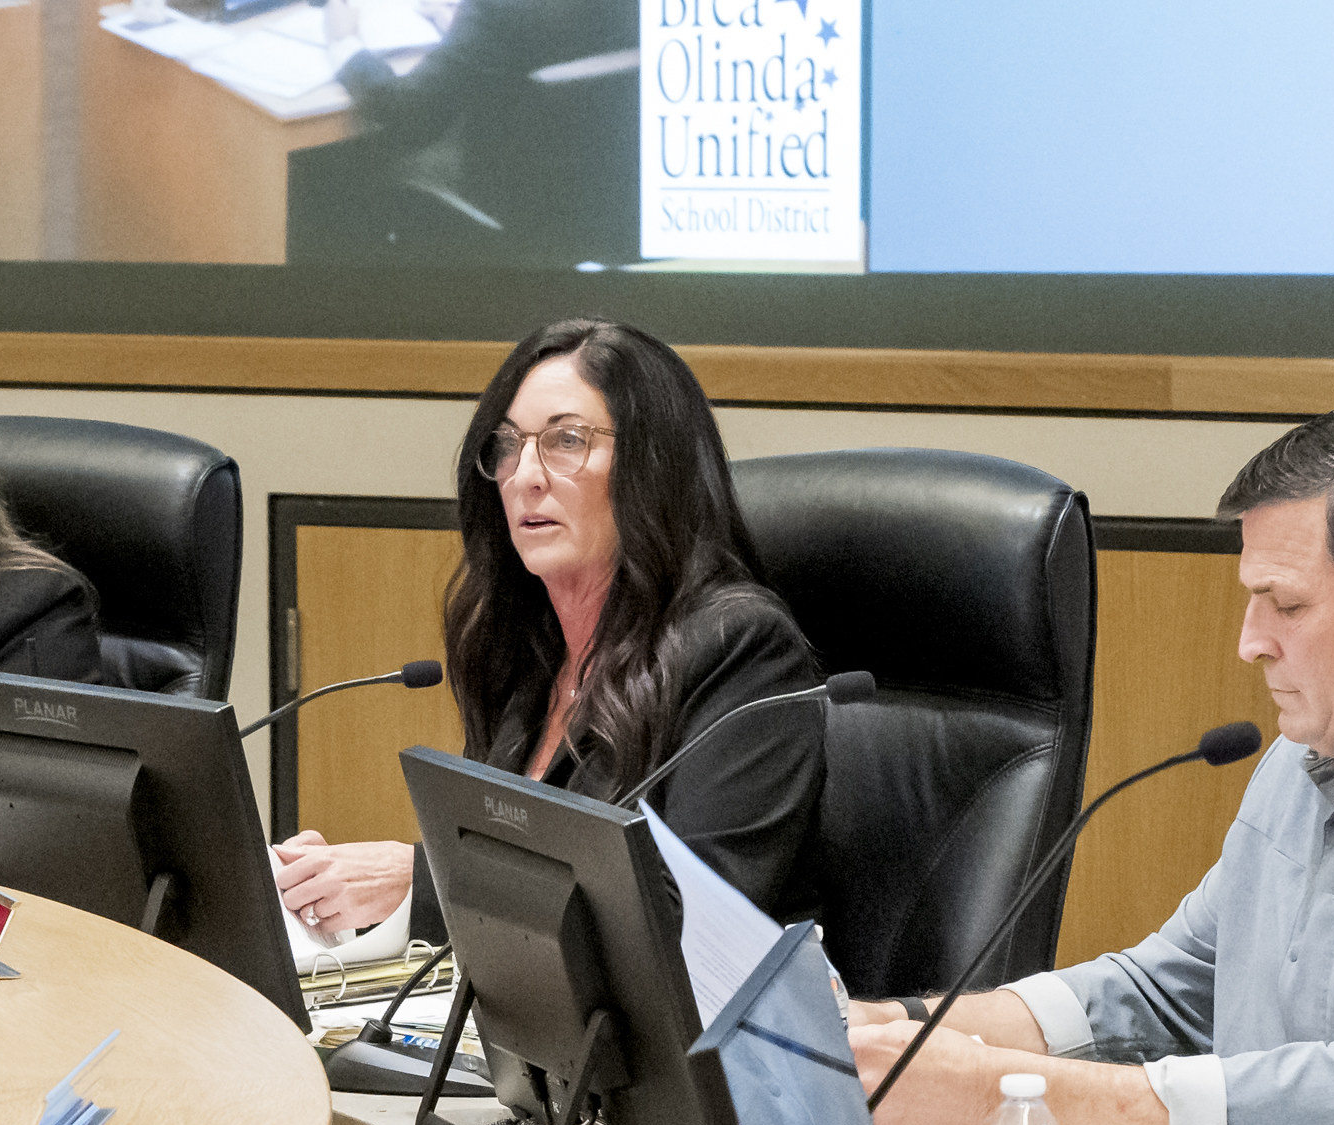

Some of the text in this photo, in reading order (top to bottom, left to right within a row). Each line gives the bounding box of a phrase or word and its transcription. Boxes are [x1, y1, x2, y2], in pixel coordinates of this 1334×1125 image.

[657, 33, 819, 103] Olinda
[657, 107, 830, 179] Unified
[661, 197, 831, 234] School District
[14, 697, 78, 721] PLANAR
[484, 795, 530, 827] PLANAR
